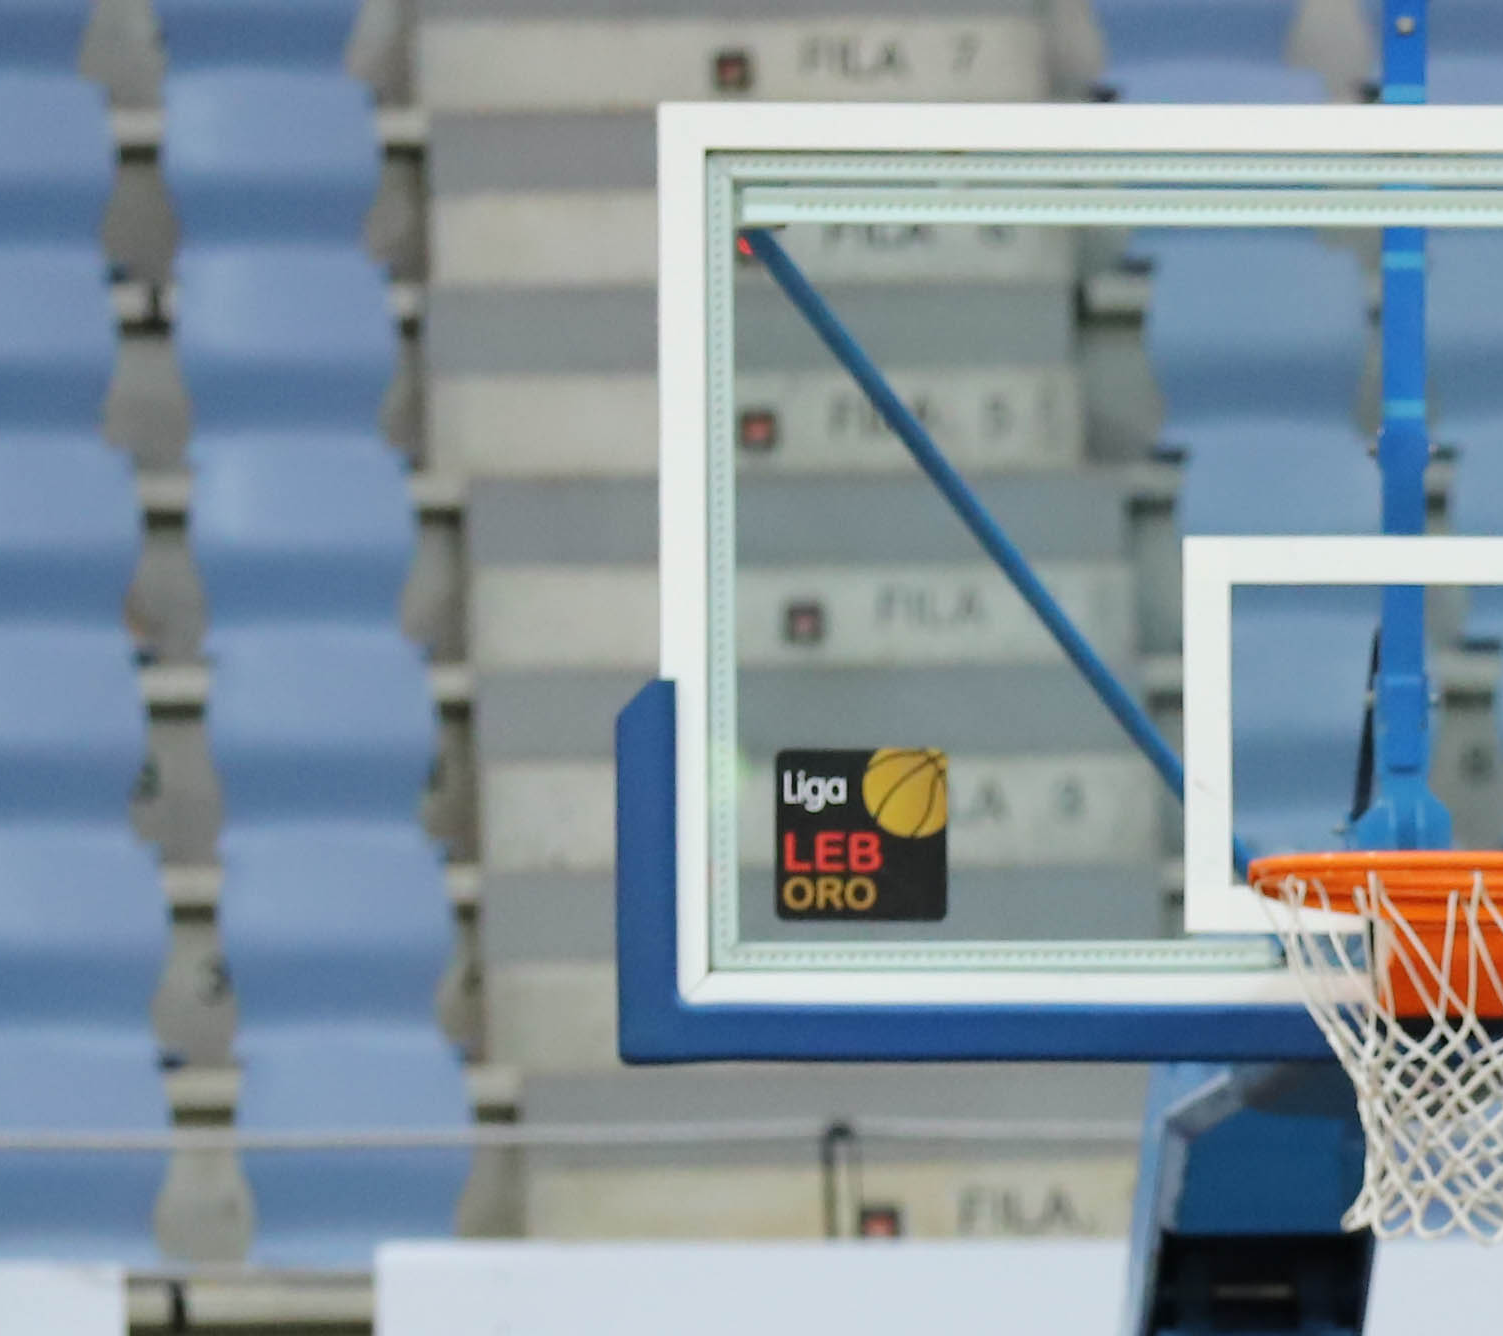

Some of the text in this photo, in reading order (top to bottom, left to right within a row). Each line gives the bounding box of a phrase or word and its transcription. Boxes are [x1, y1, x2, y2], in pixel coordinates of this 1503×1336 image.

[783, 769, 847, 813] Liga
[783, 831, 884, 873] LEB
[783, 876, 877, 910] ORO
